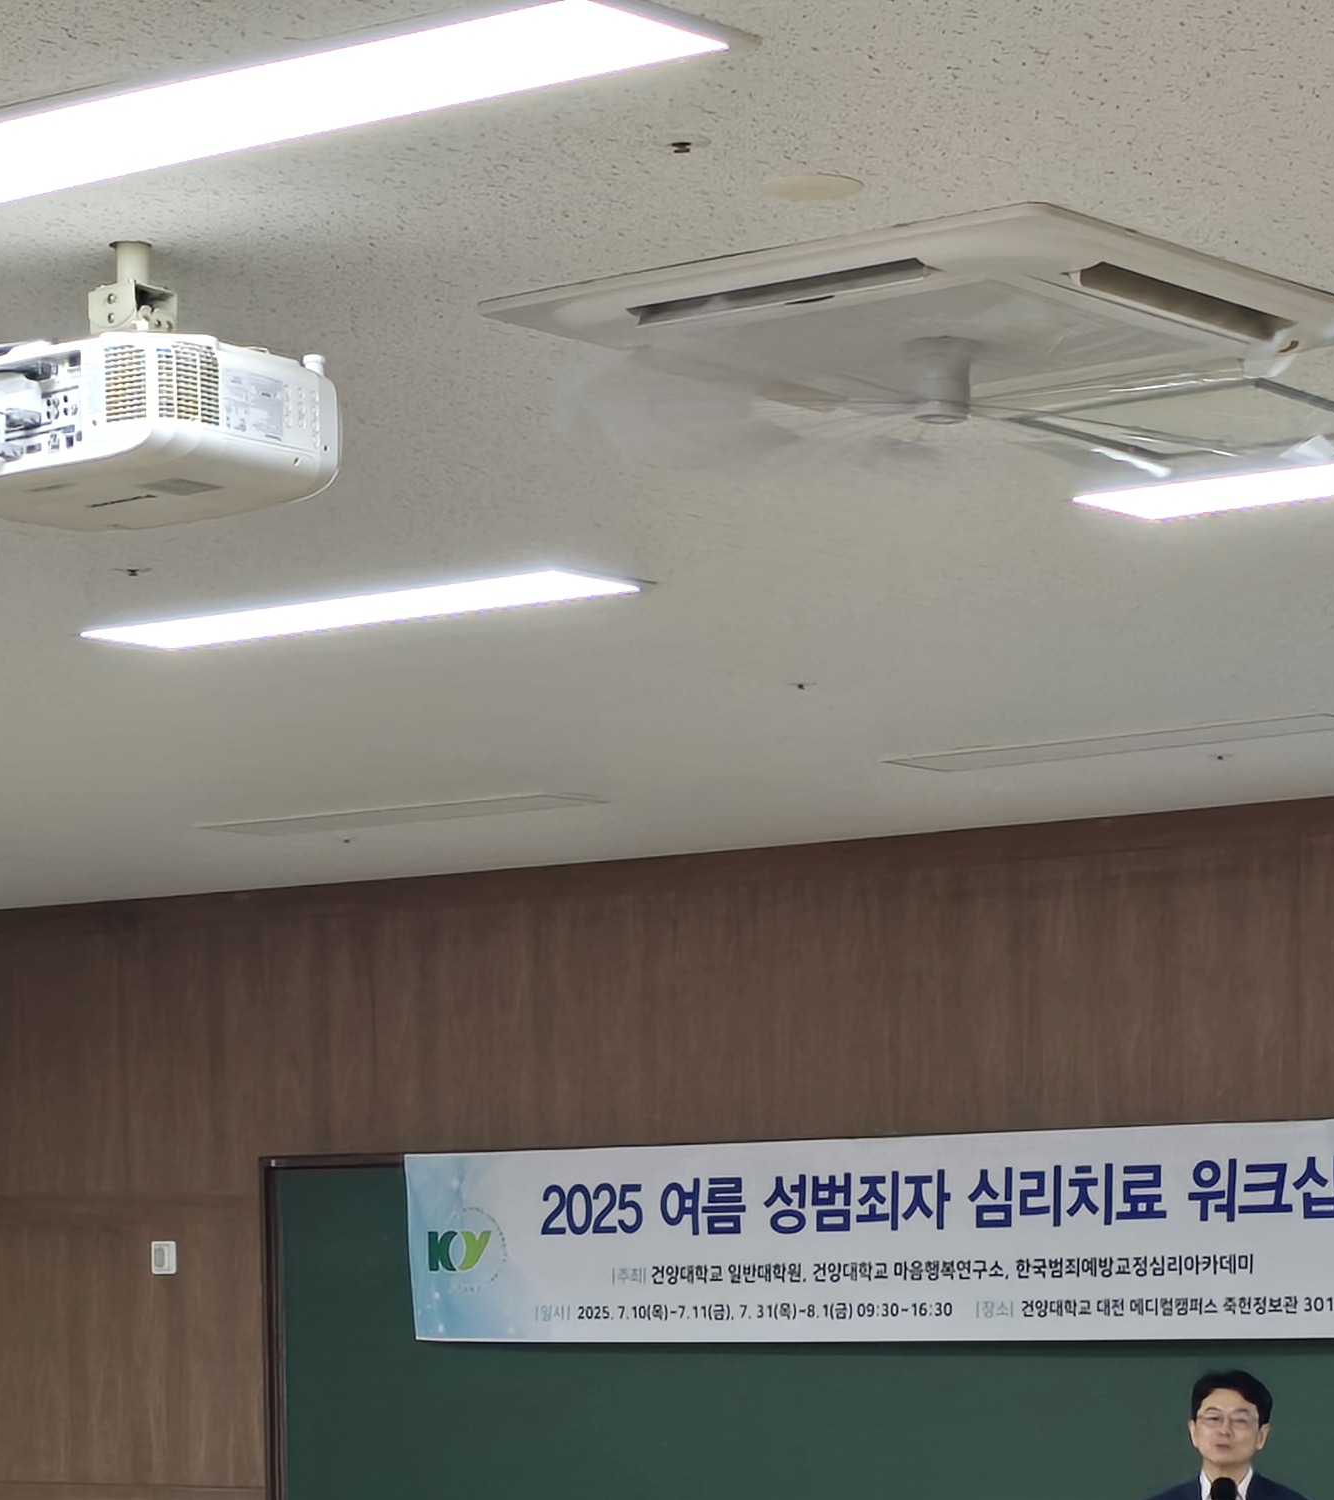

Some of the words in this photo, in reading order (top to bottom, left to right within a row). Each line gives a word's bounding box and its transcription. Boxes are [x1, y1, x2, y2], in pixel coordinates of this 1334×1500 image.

[540, 1182, 644, 1236] 2025
[659, 1176, 747, 1236] 여름
[763, 1168, 952, 1235] 성범죄자
[967, 1162, 1168, 1229] 심리치료
[651, 1264, 724, 1286] 건양대학교
[812, 1261, 889, 1283] 건양대학교
[893, 1259, 1009, 1282] 마음행복연구소,
[1015, 1253, 1254, 1280] 한국범죄예방교정심리아카데미
[856, 1301, 953, 1318] 09:30~16:30
[1021, 1299, 1092, 1319] 건양대학교
[1096, 1297, 1125, 1317] 대전
[1129, 1297, 1219, 1317] 메디컬캠퍼스
